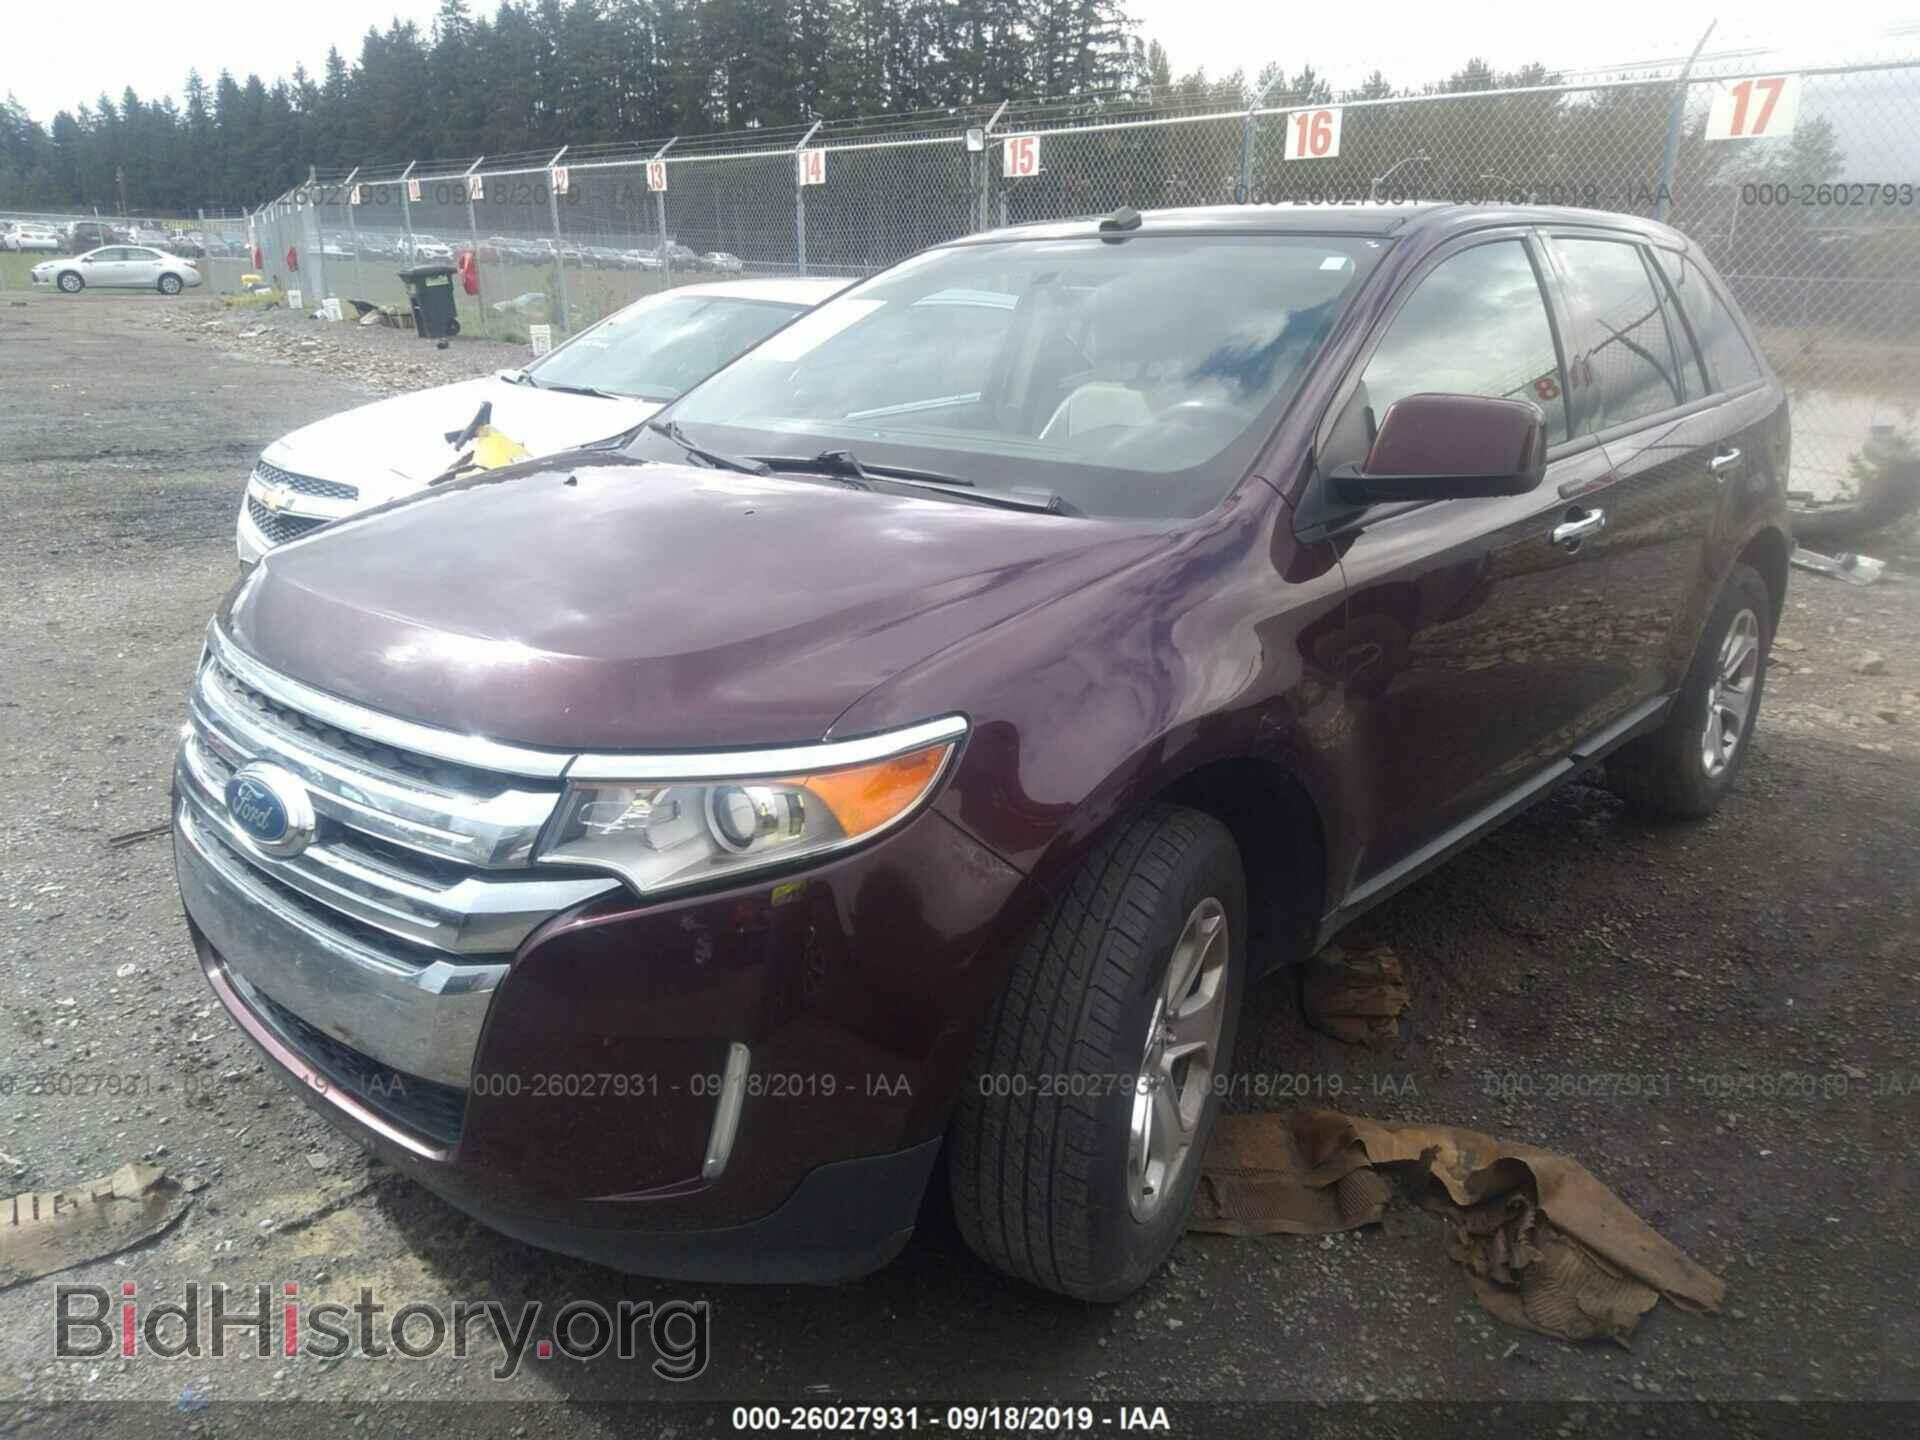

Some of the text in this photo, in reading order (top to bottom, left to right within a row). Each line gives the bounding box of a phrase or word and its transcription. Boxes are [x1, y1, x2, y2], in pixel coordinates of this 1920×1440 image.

[1729, 77, 1789, 137] 17
[1296, 109, 1333, 157] 16
[803, 150, 821, 182] 14
[1009, 137, 1035, 175] 15
[650, 163, 663, 189] 13
